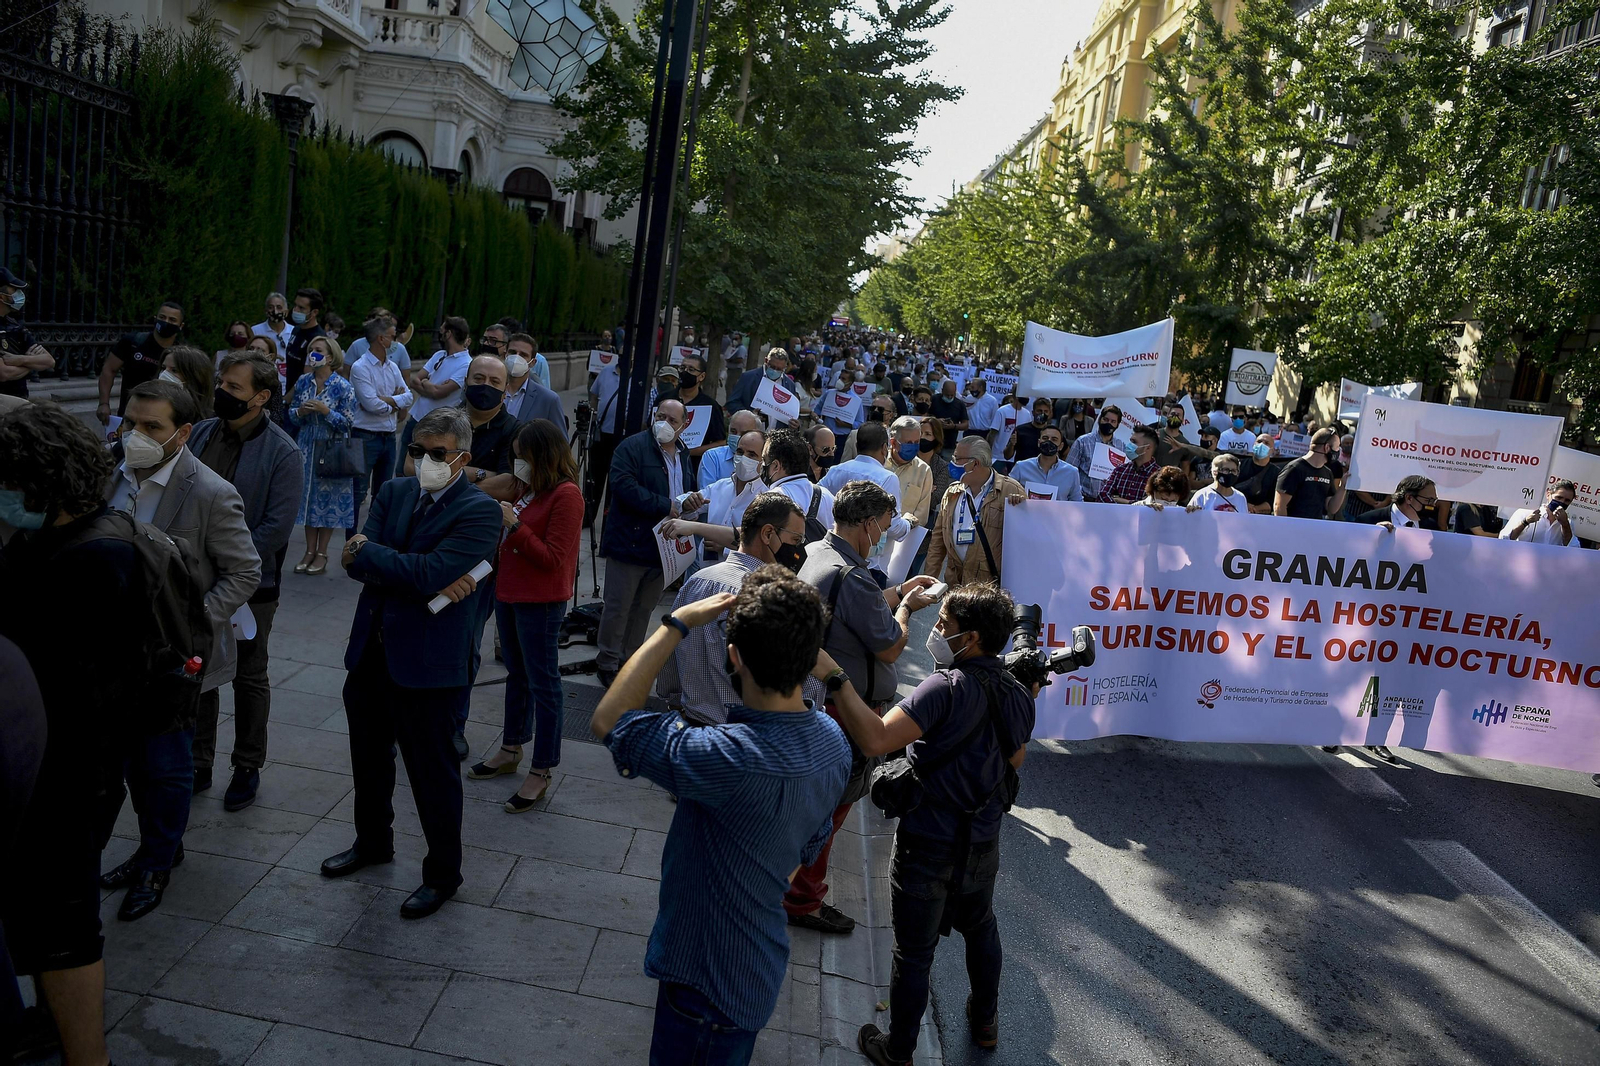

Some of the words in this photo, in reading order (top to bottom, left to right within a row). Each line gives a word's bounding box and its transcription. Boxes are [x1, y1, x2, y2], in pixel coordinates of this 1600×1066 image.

[1033, 354, 1068, 369] SOMOS
[1102, 352, 1158, 368] NOCTURNO
[1371, 437, 1417, 452] SOMOS
[1422, 444, 1456, 457] OCIO
[1461, 448, 1540, 466] NOCTURNO
[1580, 484, 1592, 494] EL
[1222, 549, 1427, 594] GRANADA
[1090, 586, 1270, 619] SALVEMOS
[1281, 598, 1321, 623] LA
[1332, 601, 1551, 650] HOSTELERÍA,
[1242, 632, 1265, 656] Y
[1274, 635, 1312, 659] EL
[1324, 638, 1398, 663] OCIO
[1093, 673, 1158, 690] HOSTELERÍA
[1092, 694, 1104, 705] DE
[1108, 688, 1148, 704] ESPAÑA
[1225, 686, 1258, 694] Federación
[1260, 688, 1289, 696] Provincial
[1384, 696, 1424, 704] ANDALUCÍA
[1514, 704, 1551, 716] ESPAÑA
